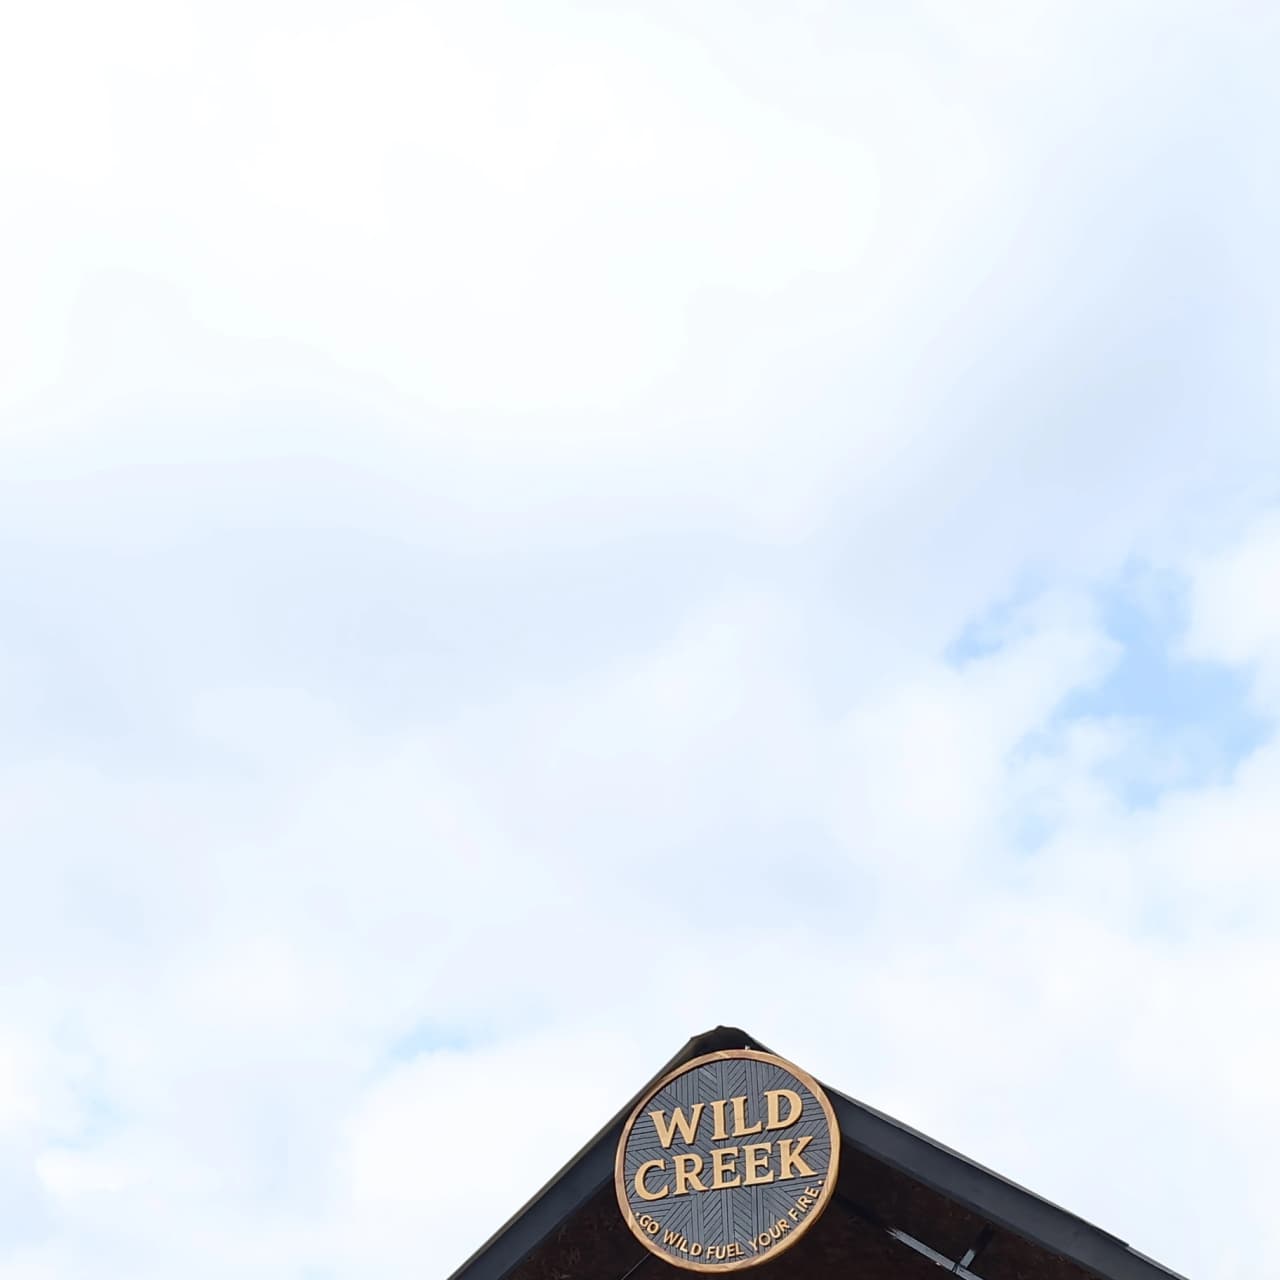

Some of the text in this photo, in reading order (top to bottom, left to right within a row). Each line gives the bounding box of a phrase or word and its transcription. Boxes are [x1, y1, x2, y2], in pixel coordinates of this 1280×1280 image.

[648, 1089, 803, 1149] WILD
[634, 1136, 818, 1200] CREEK
[663, 1228, 702, 1256] WILD
[706, 1242, 745, 1260] FUEL
[749, 1219, 791, 1251] YOUR
